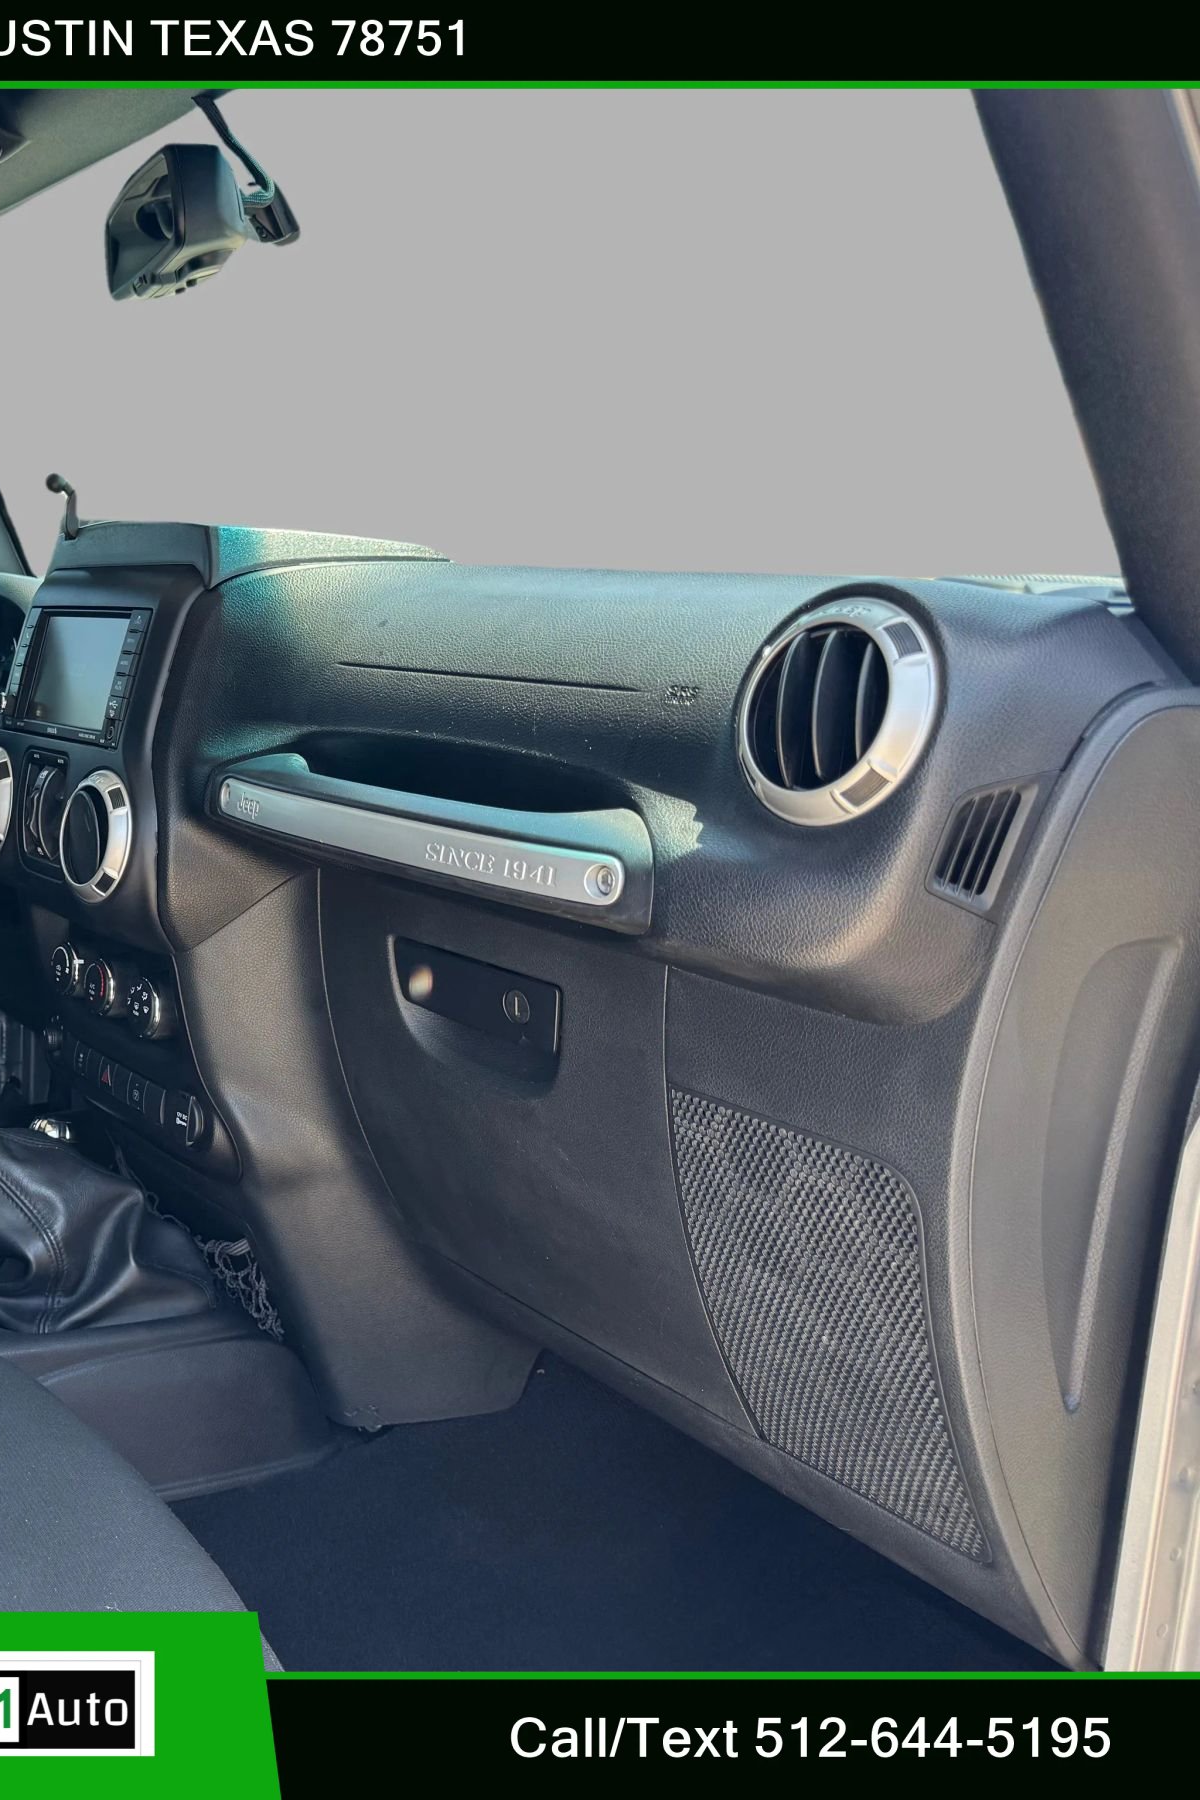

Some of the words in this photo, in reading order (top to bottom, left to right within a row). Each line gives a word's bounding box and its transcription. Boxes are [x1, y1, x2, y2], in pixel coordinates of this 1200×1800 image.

[237, 791, 260, 820] Jeep
[425, 841, 496, 875] SINCE
[503, 858, 556, 887] 1941
